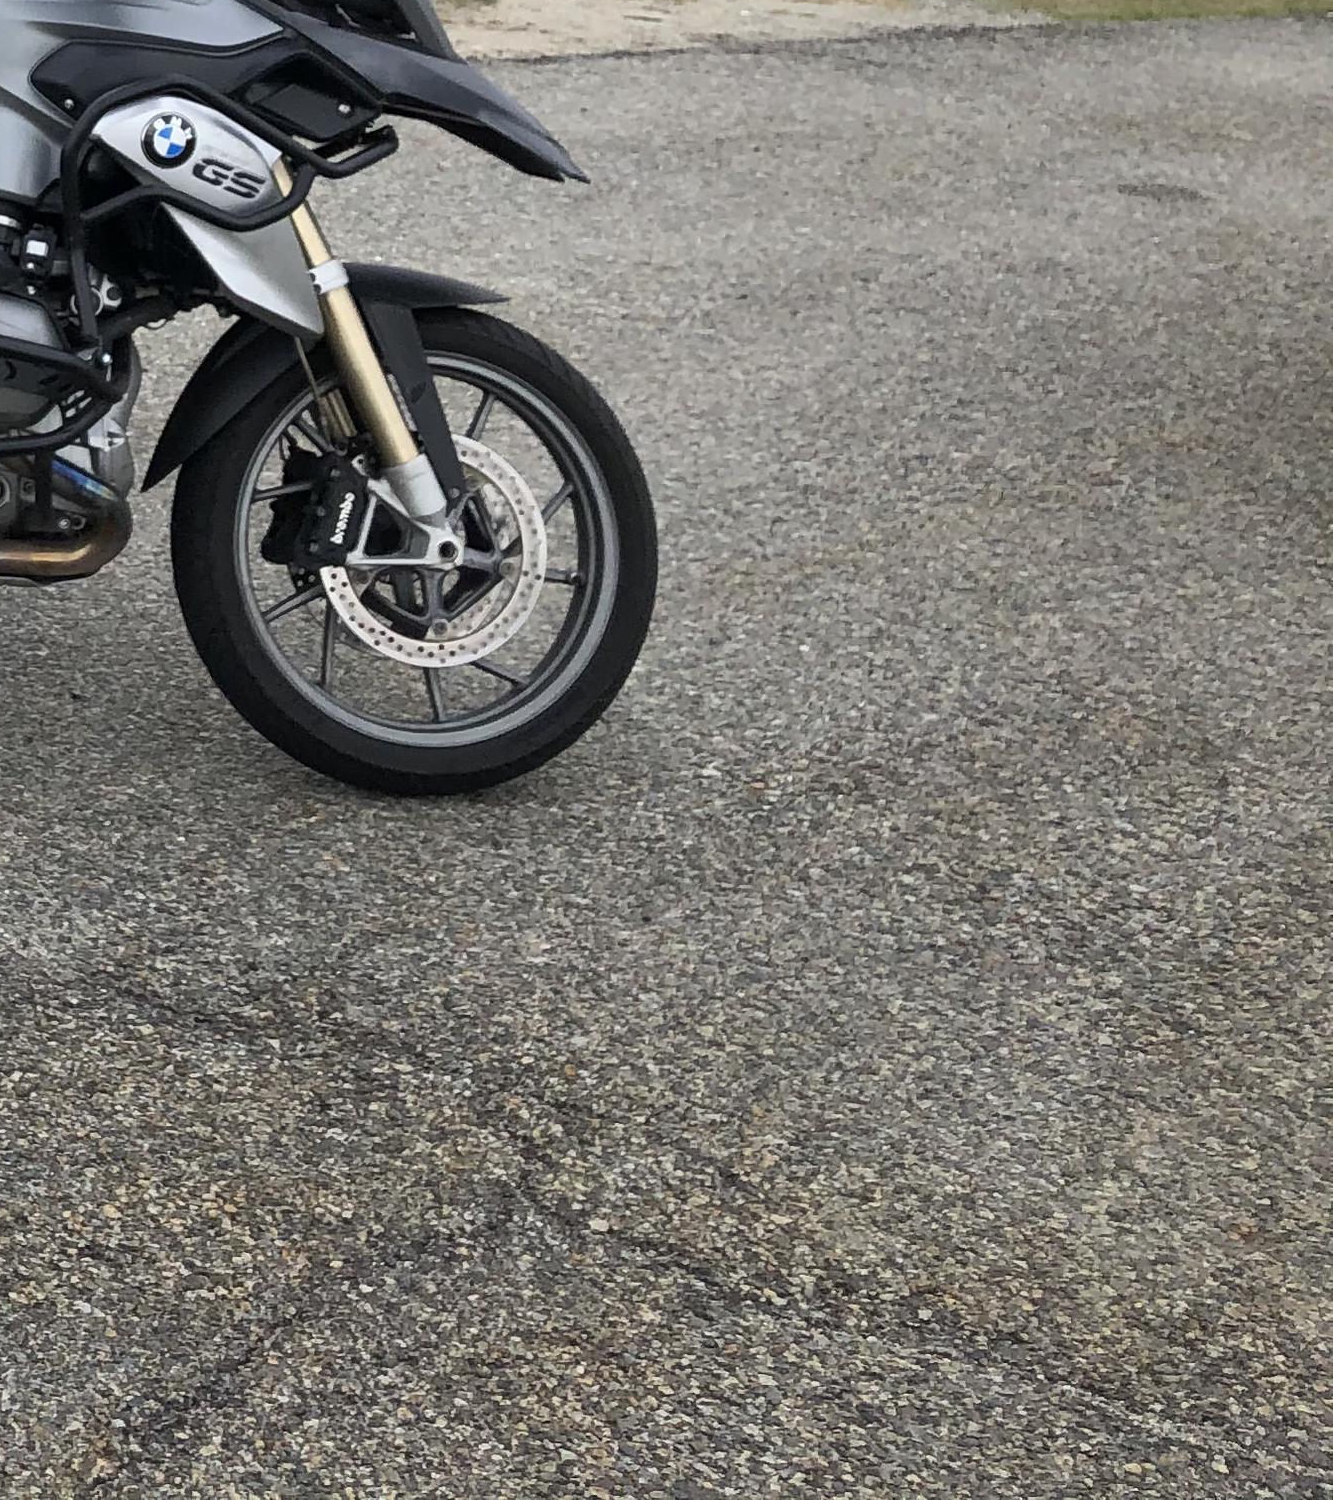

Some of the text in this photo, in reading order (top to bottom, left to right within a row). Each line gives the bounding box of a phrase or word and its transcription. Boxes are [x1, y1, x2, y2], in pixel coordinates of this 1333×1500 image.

[153, 115, 194, 140] BMW
[192, 158, 266, 199] GS
[330, 492, 355, 545] brembo
